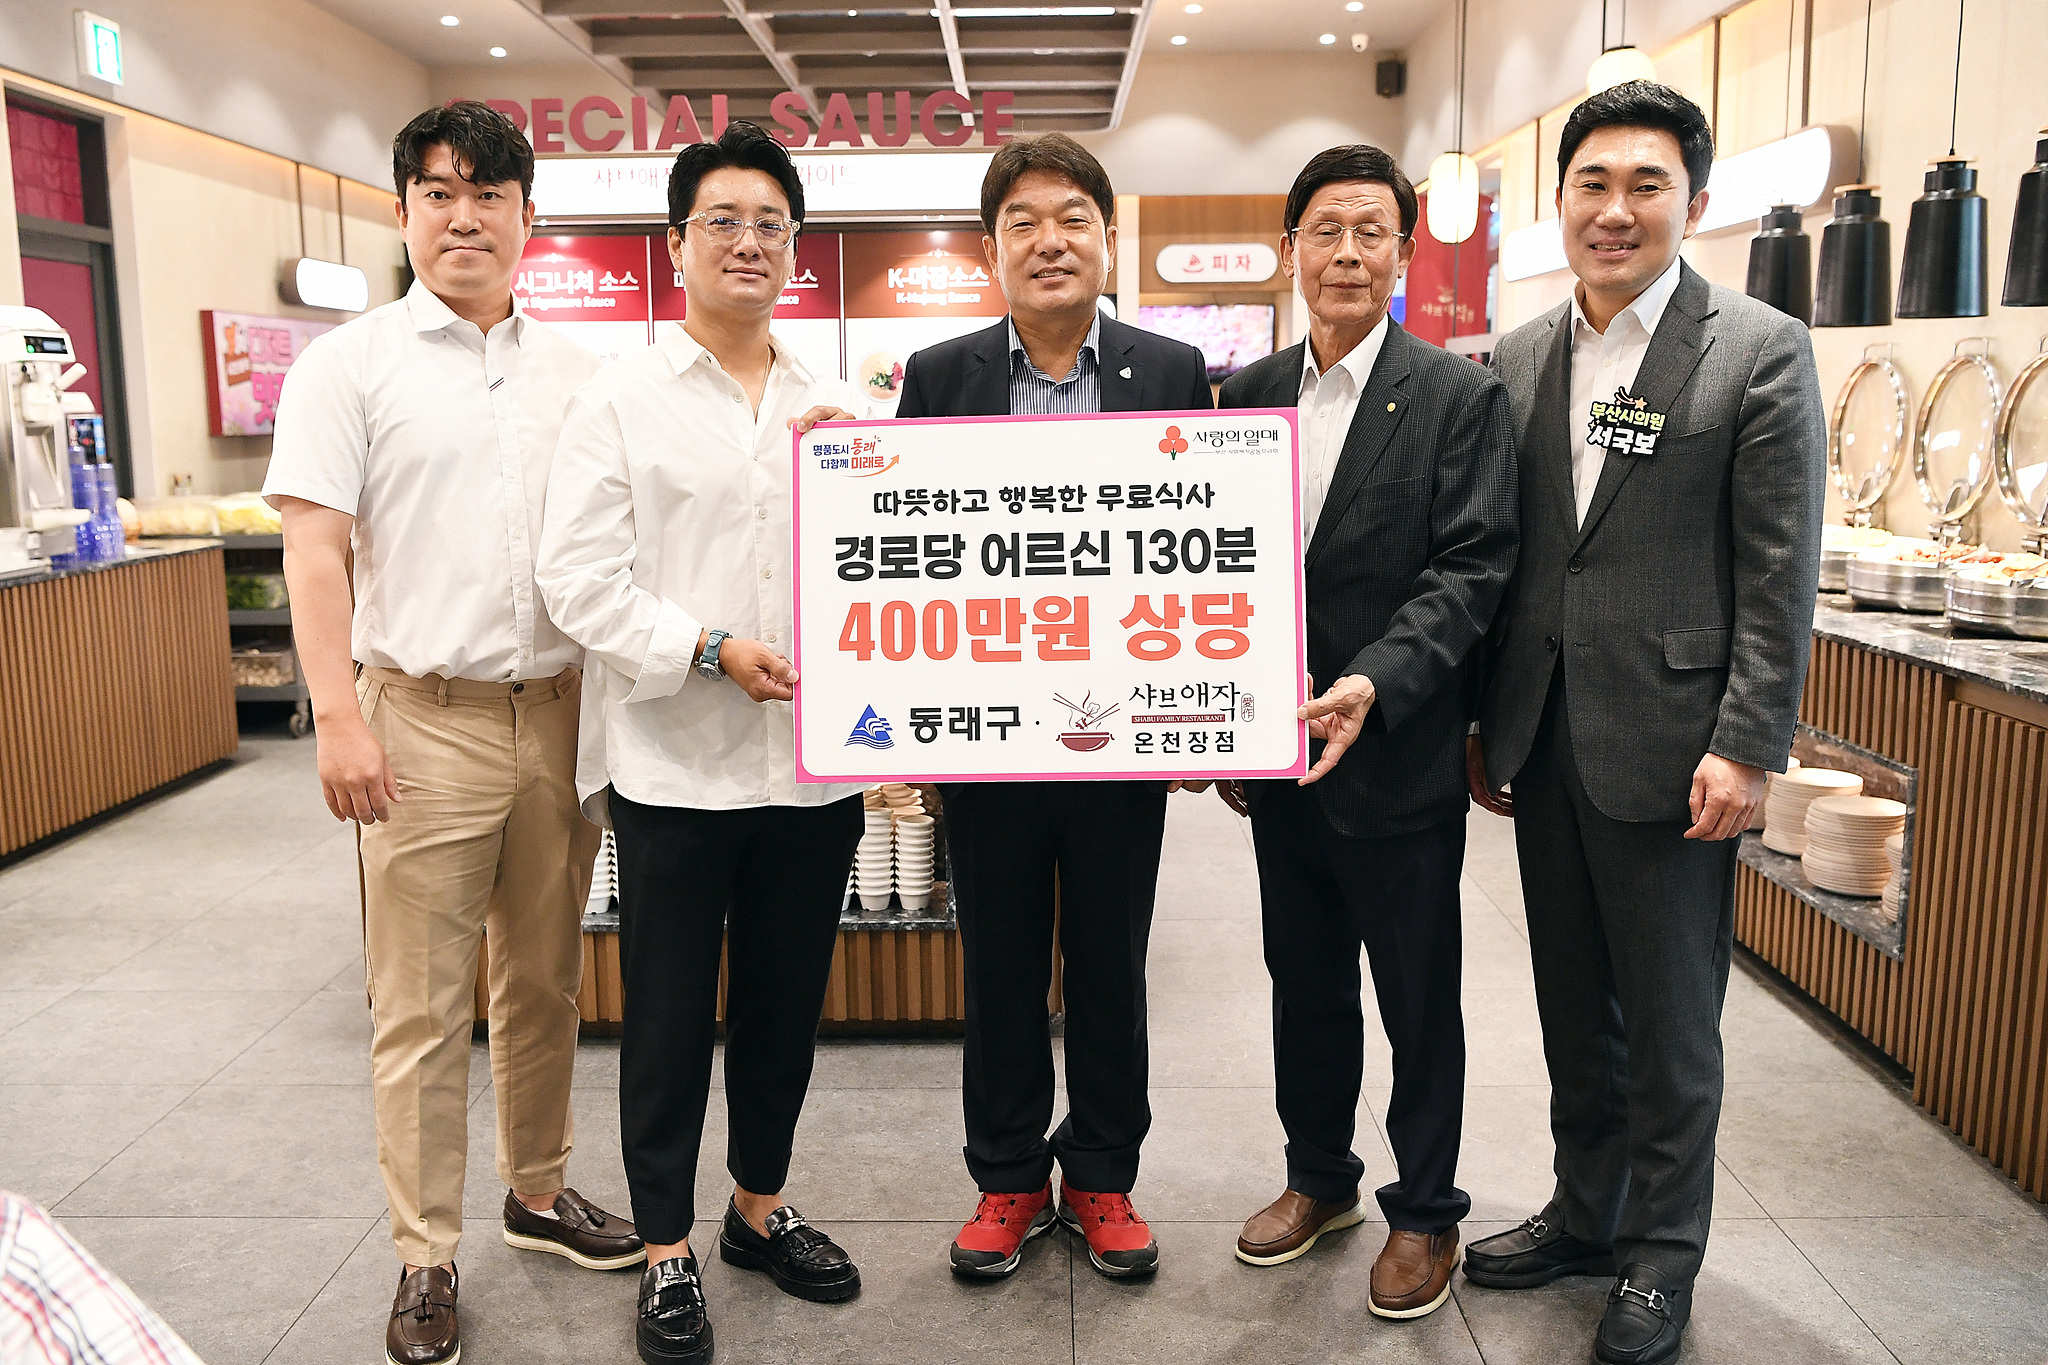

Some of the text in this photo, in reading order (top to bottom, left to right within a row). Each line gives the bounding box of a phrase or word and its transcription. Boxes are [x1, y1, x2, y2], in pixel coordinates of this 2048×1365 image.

[769, 90, 1014, 147] SAUCE
[1213, 254, 1250, 272] 피자
[599, 271, 640, 291] 소스
[888, 265, 990, 290] K-마장소스
[582, 296, 616, 308] Sauce
[1591, 402, 1666, 432] 부산시의원
[813, 438, 876, 456] 명품도시 동래
[1193, 429, 1279, 448] 사랑의 열매
[1587, 425, 1657, 455] 서국보
[820, 456, 885, 470] 다함께 미래로
[873, 481, 1216, 517] 따뜻하고 행복한 무료식사
[835, 526, 1257, 582] 경로당 어르신 130분
[838, 592, 1255, 663] 400만원 상당
[1128, 680, 1241, 722] 샤브애작
[908, 705, 1022, 744] 동래구
[1133, 714, 1224, 723] SHABU FAMILY RESTAURANT
[1134, 730, 1234, 755] 온천장점
